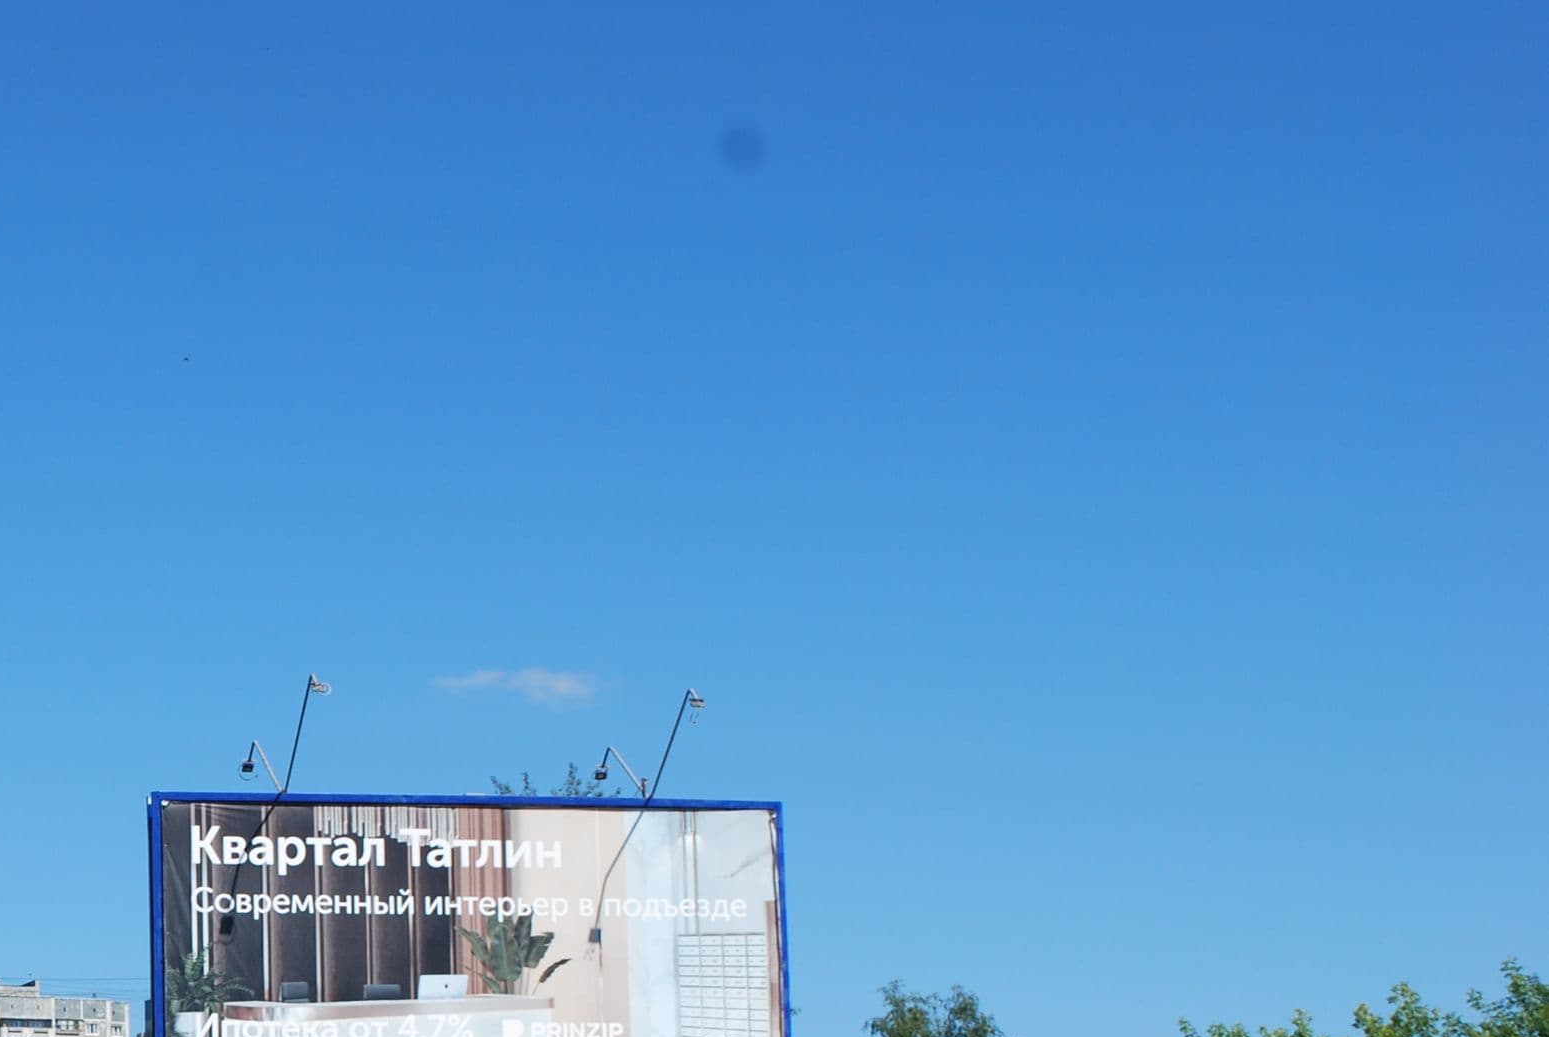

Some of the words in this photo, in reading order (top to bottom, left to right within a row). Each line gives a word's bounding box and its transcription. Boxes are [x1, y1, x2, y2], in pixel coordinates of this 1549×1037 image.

[191, 824, 386, 876] Квартал
[399, 828, 563, 868] Татлин
[191, 886, 415, 920] Современный
[425, 894, 569, 922] интерьер
[578, 897, 594, 917] в
[604, 897, 748, 921] подъезде
